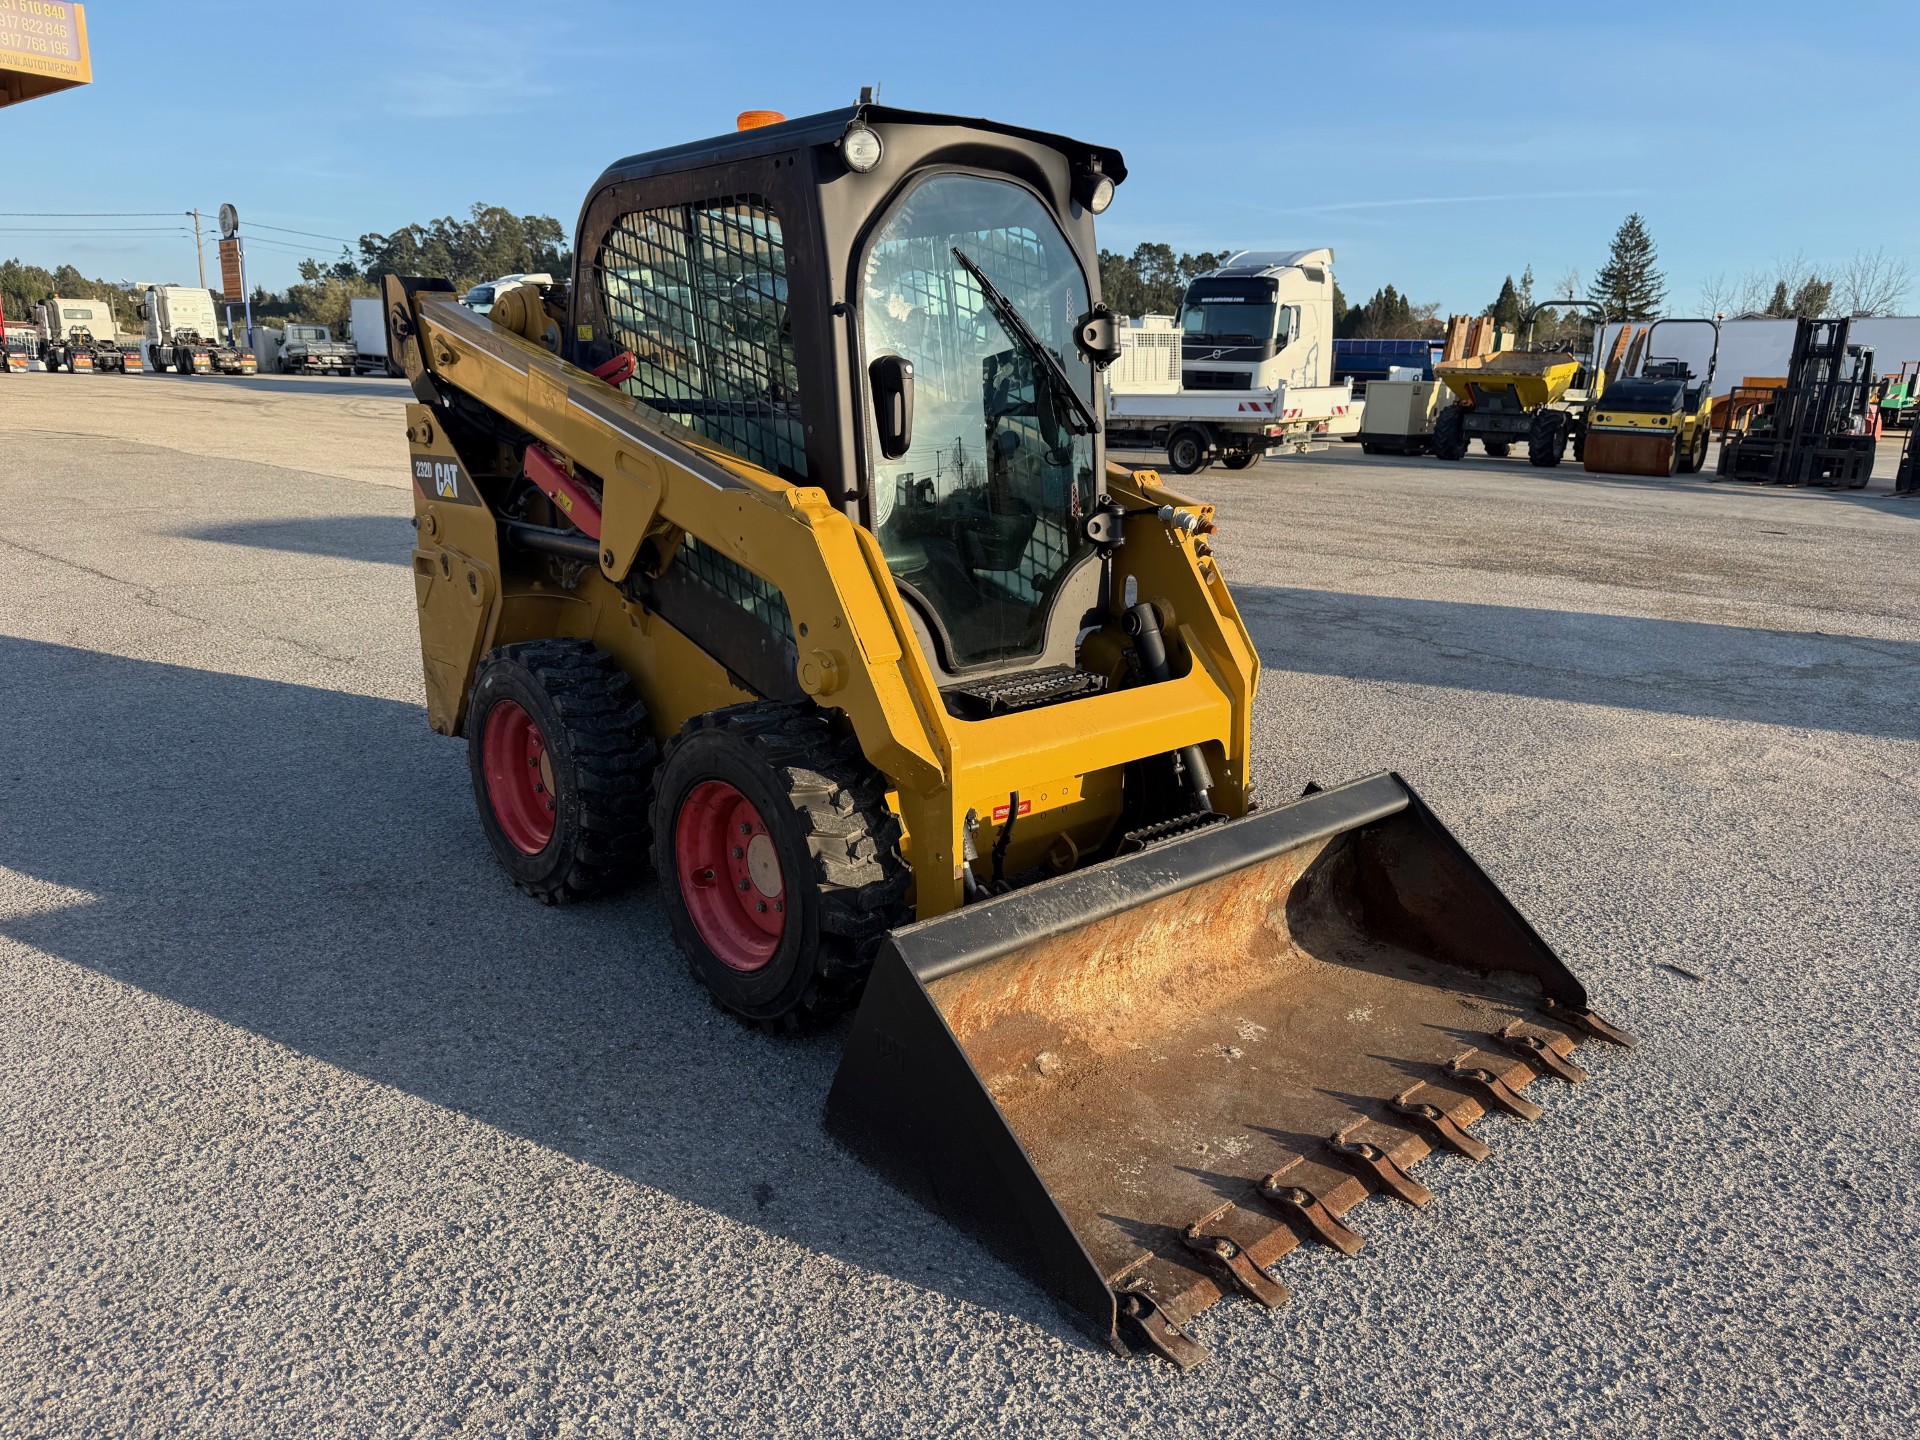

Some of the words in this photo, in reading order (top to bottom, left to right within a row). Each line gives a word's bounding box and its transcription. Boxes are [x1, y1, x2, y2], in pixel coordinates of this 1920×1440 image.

[0, 0, 16, 10] 31
[20, 0, 41, 15] 510
[44, 4, 65, 20] 840
[22, 17, 44, 34] 822
[45, 22, 67, 38] 846
[1, 31, 21, 48] 917
[24, 35, 47, 52] 768
[49, 40, 69, 56] 195
[416, 461, 432, 478] 232D
[434, 462, 458, 498] CAT
